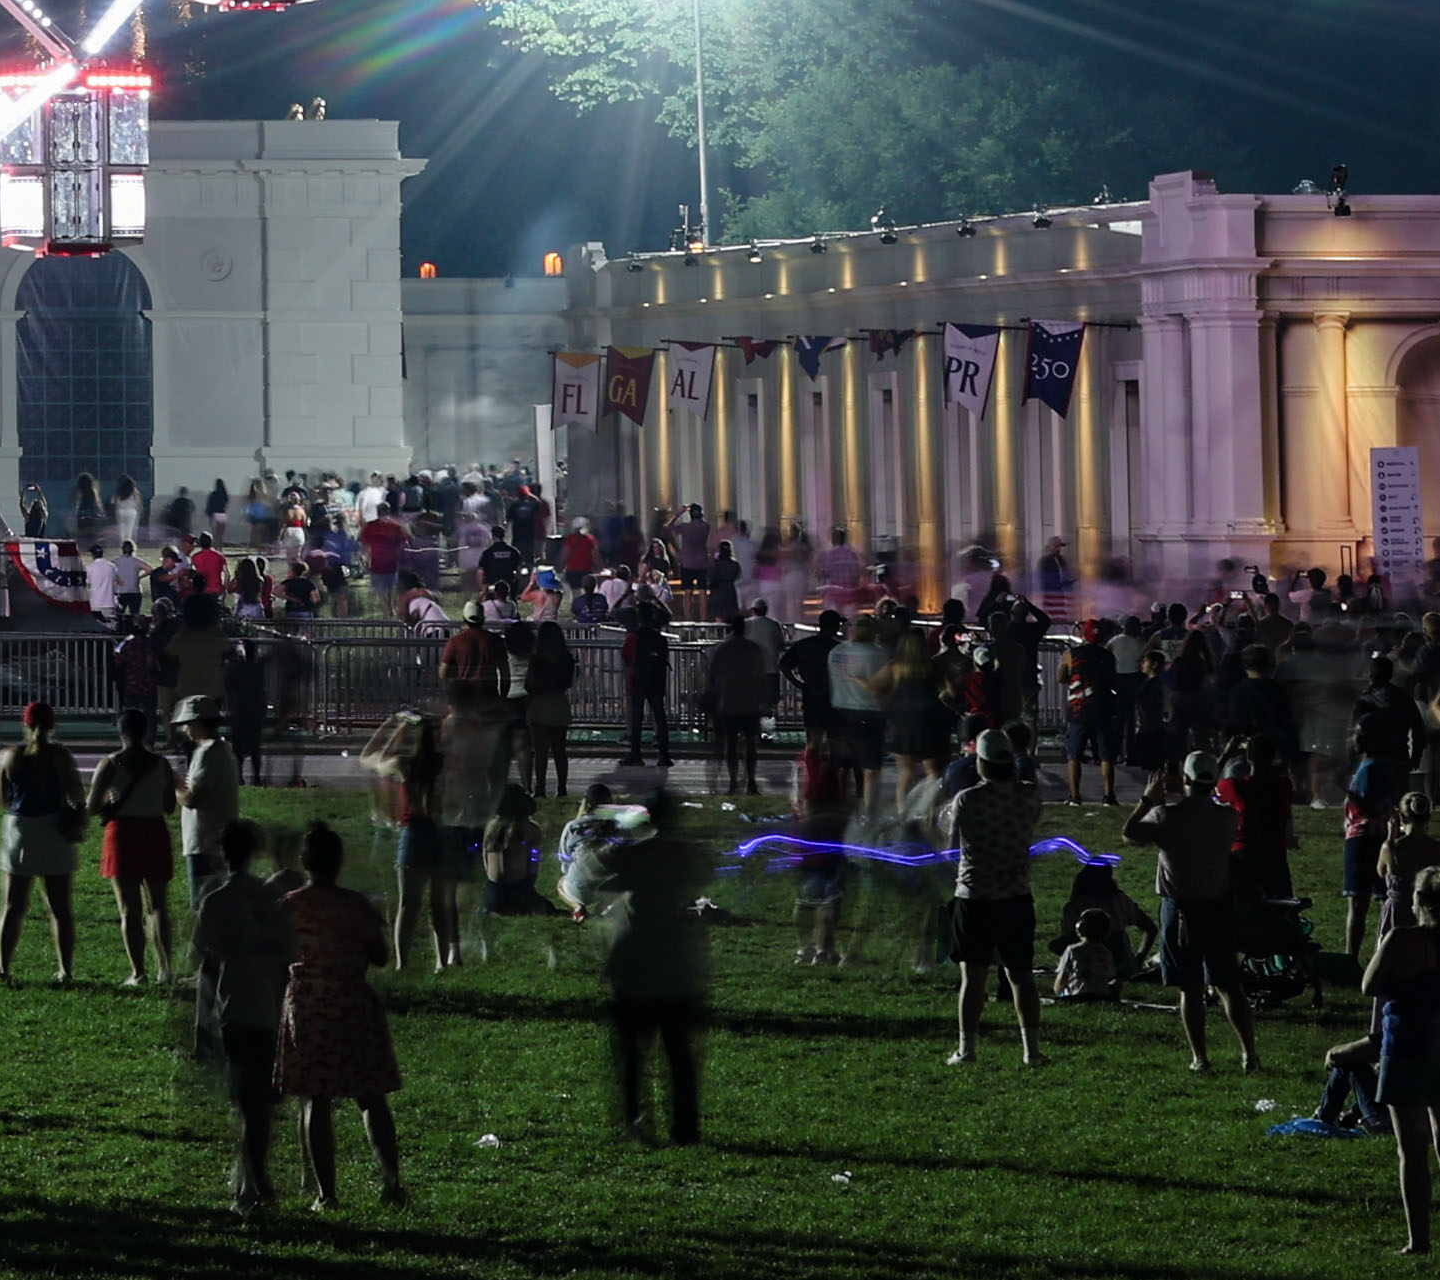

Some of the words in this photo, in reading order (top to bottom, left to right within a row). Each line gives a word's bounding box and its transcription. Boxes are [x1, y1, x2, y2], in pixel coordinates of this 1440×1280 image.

[944, 355, 981, 398] PR
[1030, 354, 1071, 381] 250
[561, 383, 589, 416] FL
[608, 375, 637, 407] GA
[670, 368, 700, 401] AL
